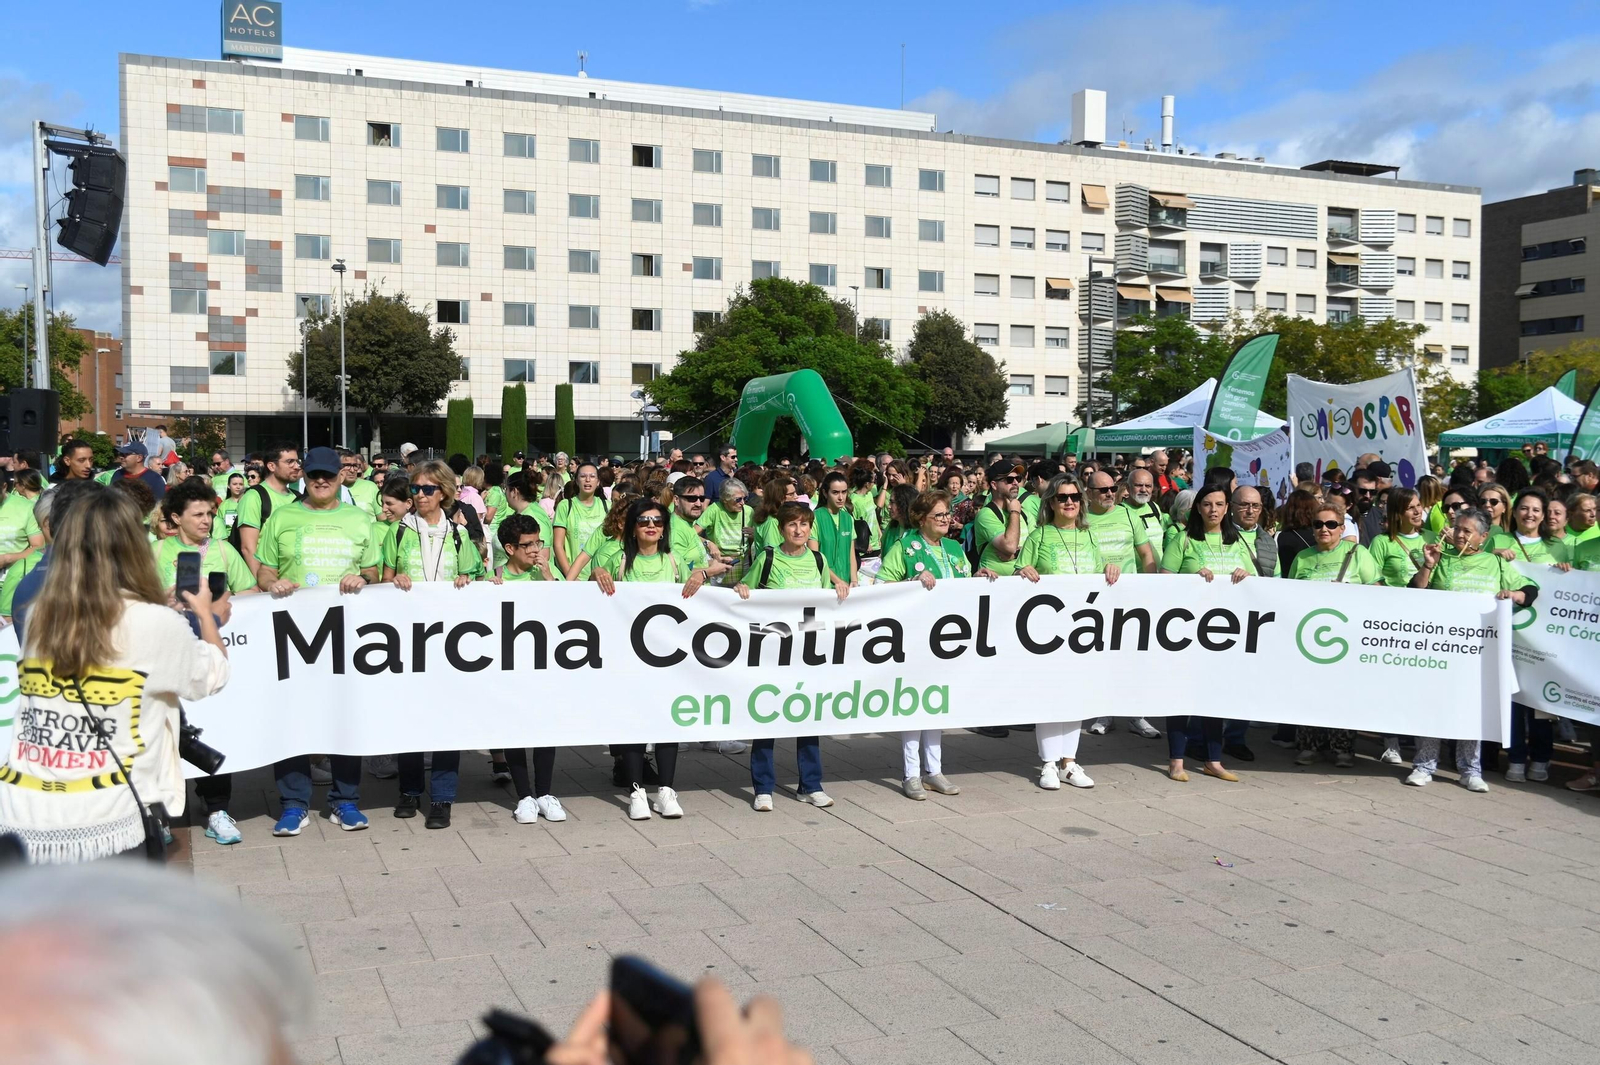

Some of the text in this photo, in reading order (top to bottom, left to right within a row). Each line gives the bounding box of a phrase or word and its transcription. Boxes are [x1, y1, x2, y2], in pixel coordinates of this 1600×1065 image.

[230, 3, 275, 27] AC
[229, 27, 276, 38] HOTELS
[230, 43, 275, 54] MARRIOTT
[1227, 385, 1255, 396] Tenemos
[1223, 400, 1246, 408] camino
[1379, 395, 1415, 440] POR
[1122, 433, 1147, 441] ESPAÑOLA
[303, 546, 340, 555] contra
[1550, 606, 1599, 624] contra
[1362, 618, 1444, 635] asociación
[1546, 623, 1565, 635] en
[222, 632, 248, 647] ola
[272, 591, 1275, 681] Marcha Contra el Cáncer
[1361, 636, 1485, 655] contra el cáncer
[1359, 652, 1448, 670] en Córdoba
[670, 677, 950, 727] en Córdoba
[1564, 693, 1581, 702] contra
[17, 741, 108, 770] WOMEN
